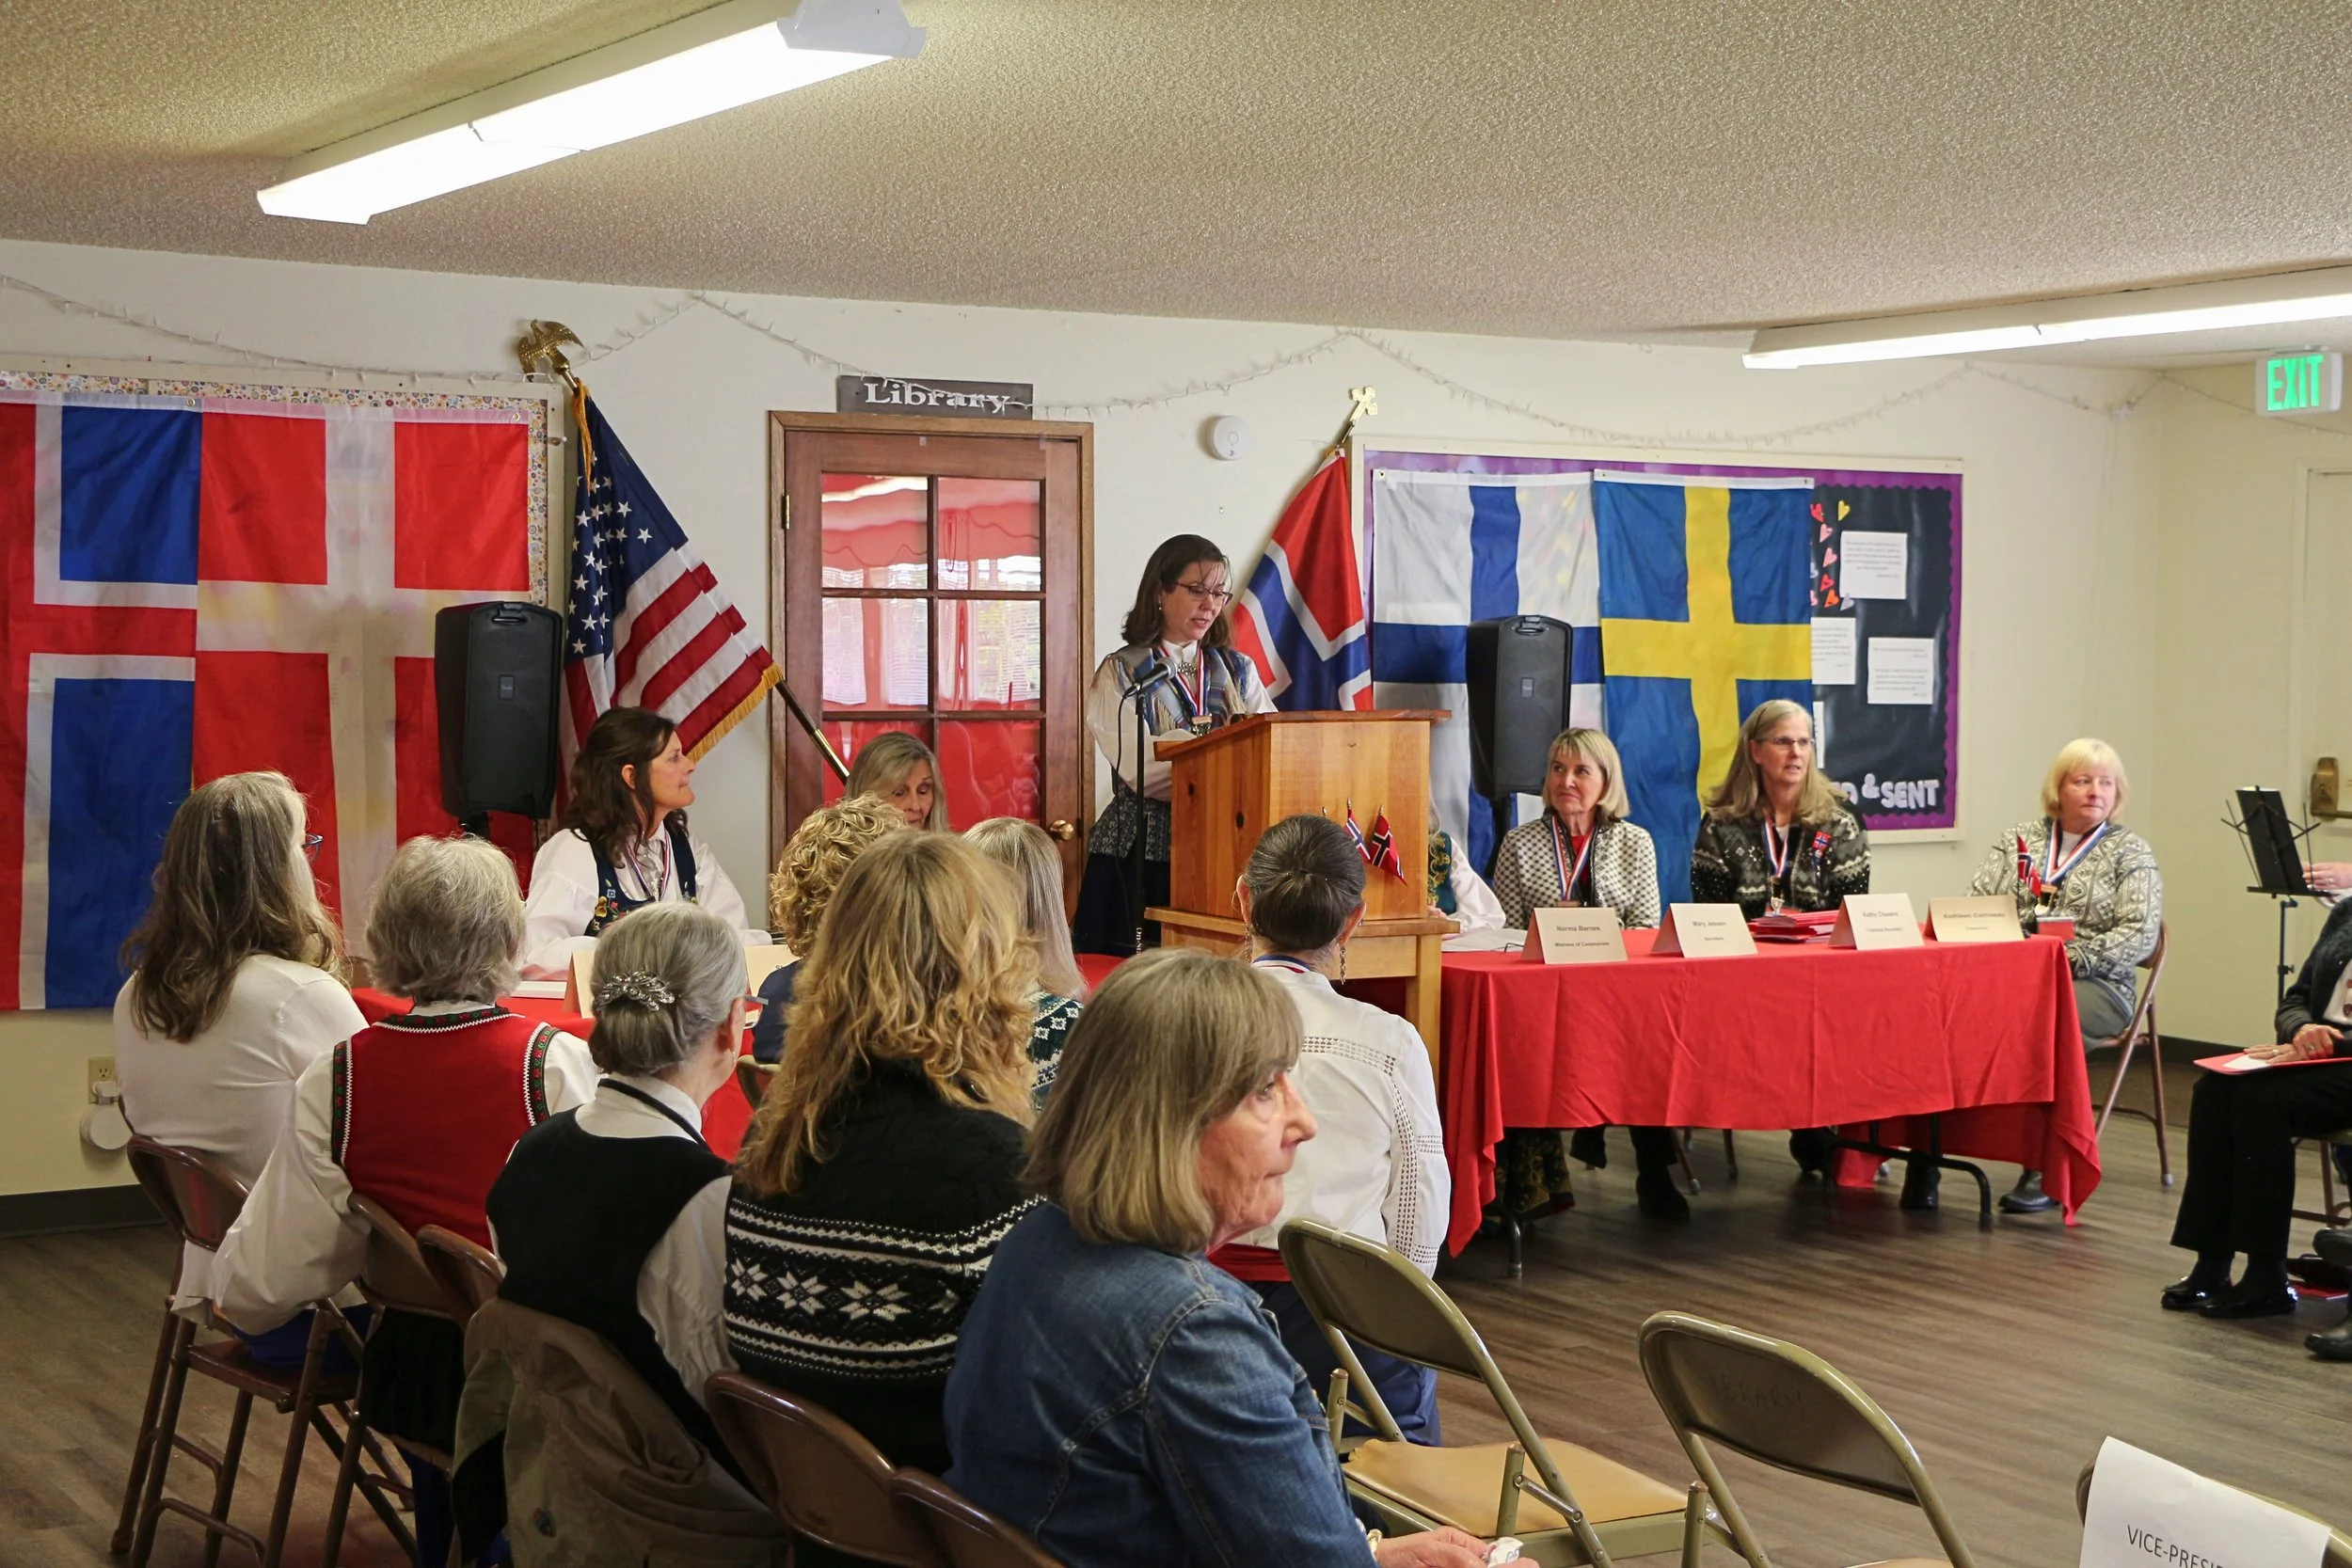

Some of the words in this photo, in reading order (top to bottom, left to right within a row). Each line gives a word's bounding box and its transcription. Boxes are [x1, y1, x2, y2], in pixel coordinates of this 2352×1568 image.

[864, 383, 1010, 414] Library
[2267, 354, 2324, 411] EXIT
[1861, 772, 1880, 799] &
[1881, 779, 1939, 809] SENT
[2127, 1524, 2224, 1568] VICE-PRES
